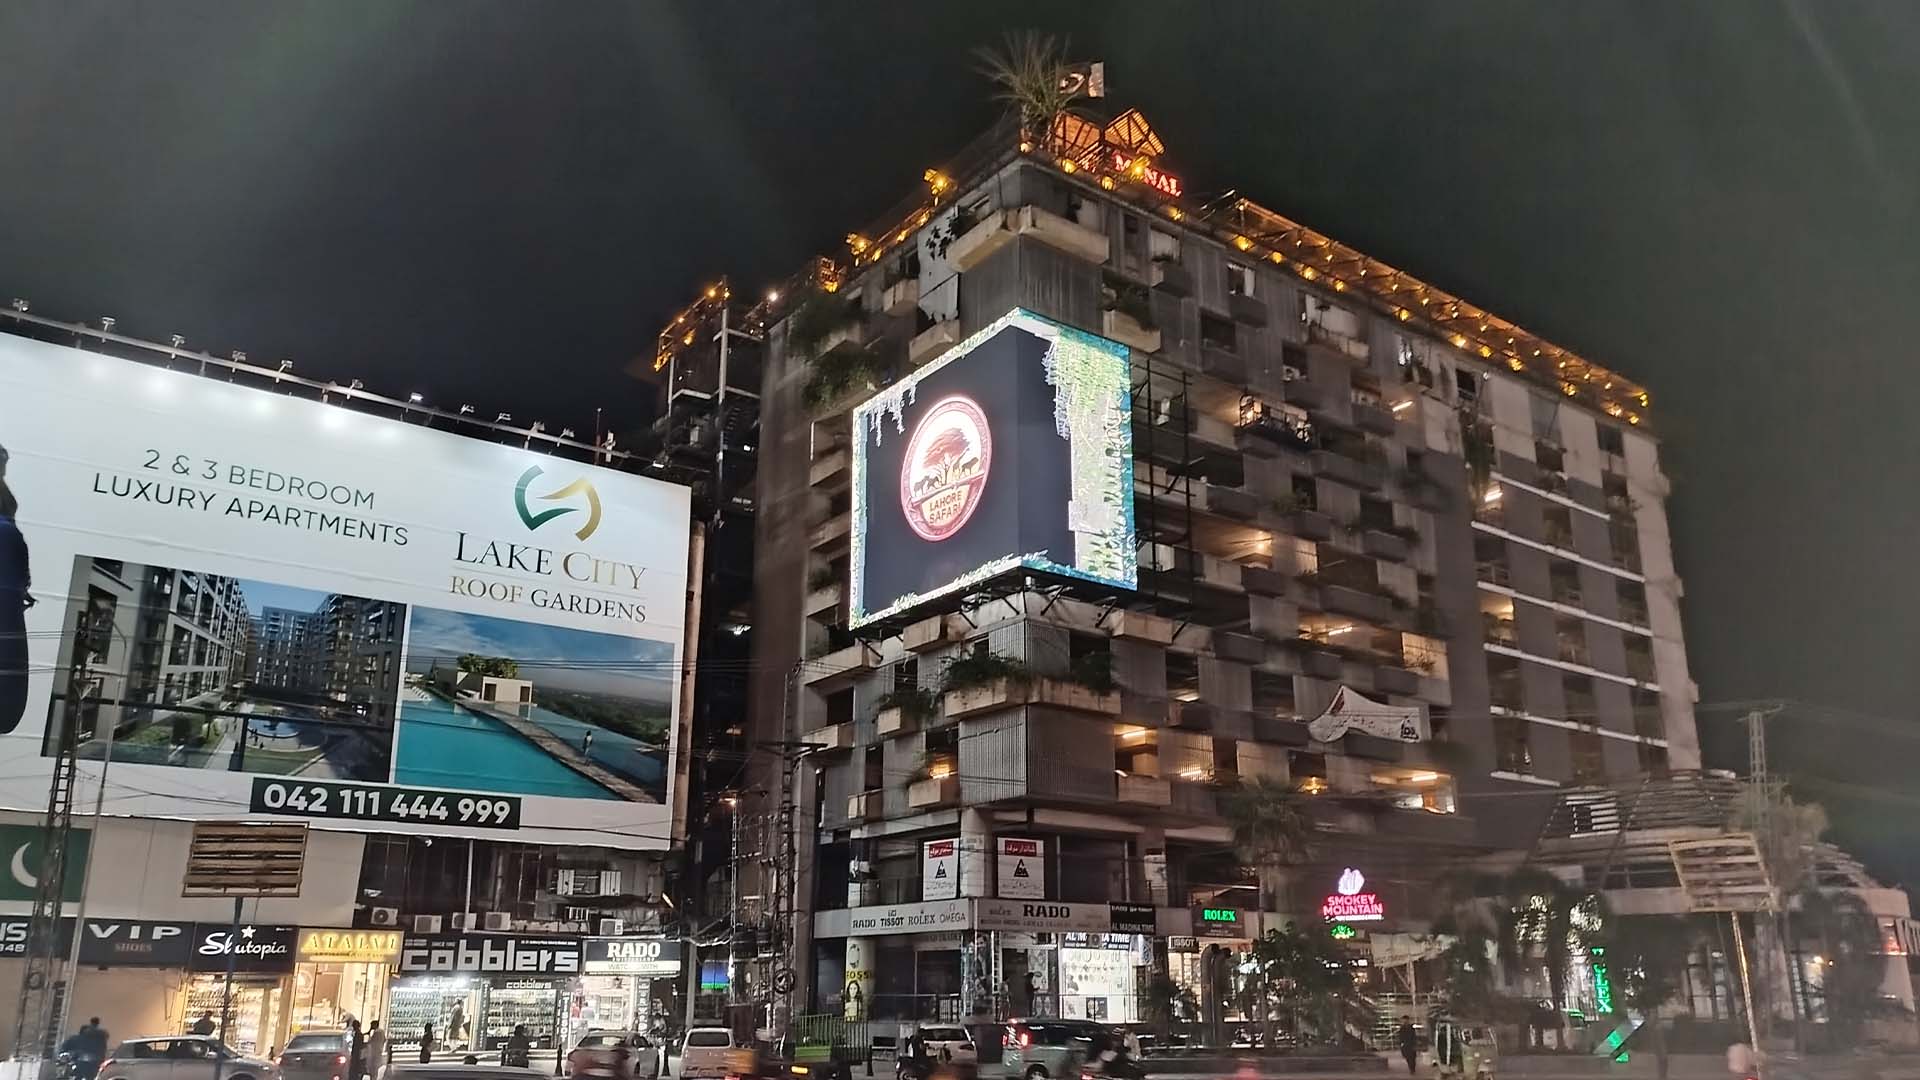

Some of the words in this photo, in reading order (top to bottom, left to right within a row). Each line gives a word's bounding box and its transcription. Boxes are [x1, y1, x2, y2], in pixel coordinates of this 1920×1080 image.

[1115, 154, 1182, 196] MNAL
[144, 449, 160, 470] 2
[172, 455, 190, 475] &
[202, 459, 217, 480] 3
[229, 465, 375, 510] BEDROOM
[93, 472, 216, 511] LUXURY
[225, 498, 408, 546] APARTMENTS
[929, 491, 962, 512] LAHORE
[929, 503, 961, 524] SAFARI
[453, 531, 553, 576] LAKE
[563, 551, 649, 590] CITY
[449, 575, 523, 603] ROOF
[531, 589, 646, 623] GARDENS
[263, 783, 329, 814] 042
[339, 789, 380, 816] 111
[390, 793, 448, 820] 444
[457, 798, 511, 825] 999
[1323, 903, 1384, 916] MOUNTAIN
[1327, 894, 1376, 906] SMOKEY
[853, 919, 876, 929] RADO
[880, 917, 904, 928] TISSOT
[908, 914, 935, 926] ROLEX
[940, 912, 966, 923] OMEGA
[1023, 904, 1071, 919] RADO
[1204, 909, 1236, 921] ROLEX
[88, 924, 182, 940] VIP
[1111, 934, 1130, 943] TIME
[402, 939, 579, 972] cobblers
[607, 942, 660, 958] RADO
[506, 979, 551, 989] cobblers
[560, 997, 570, 1042] TISSOT
